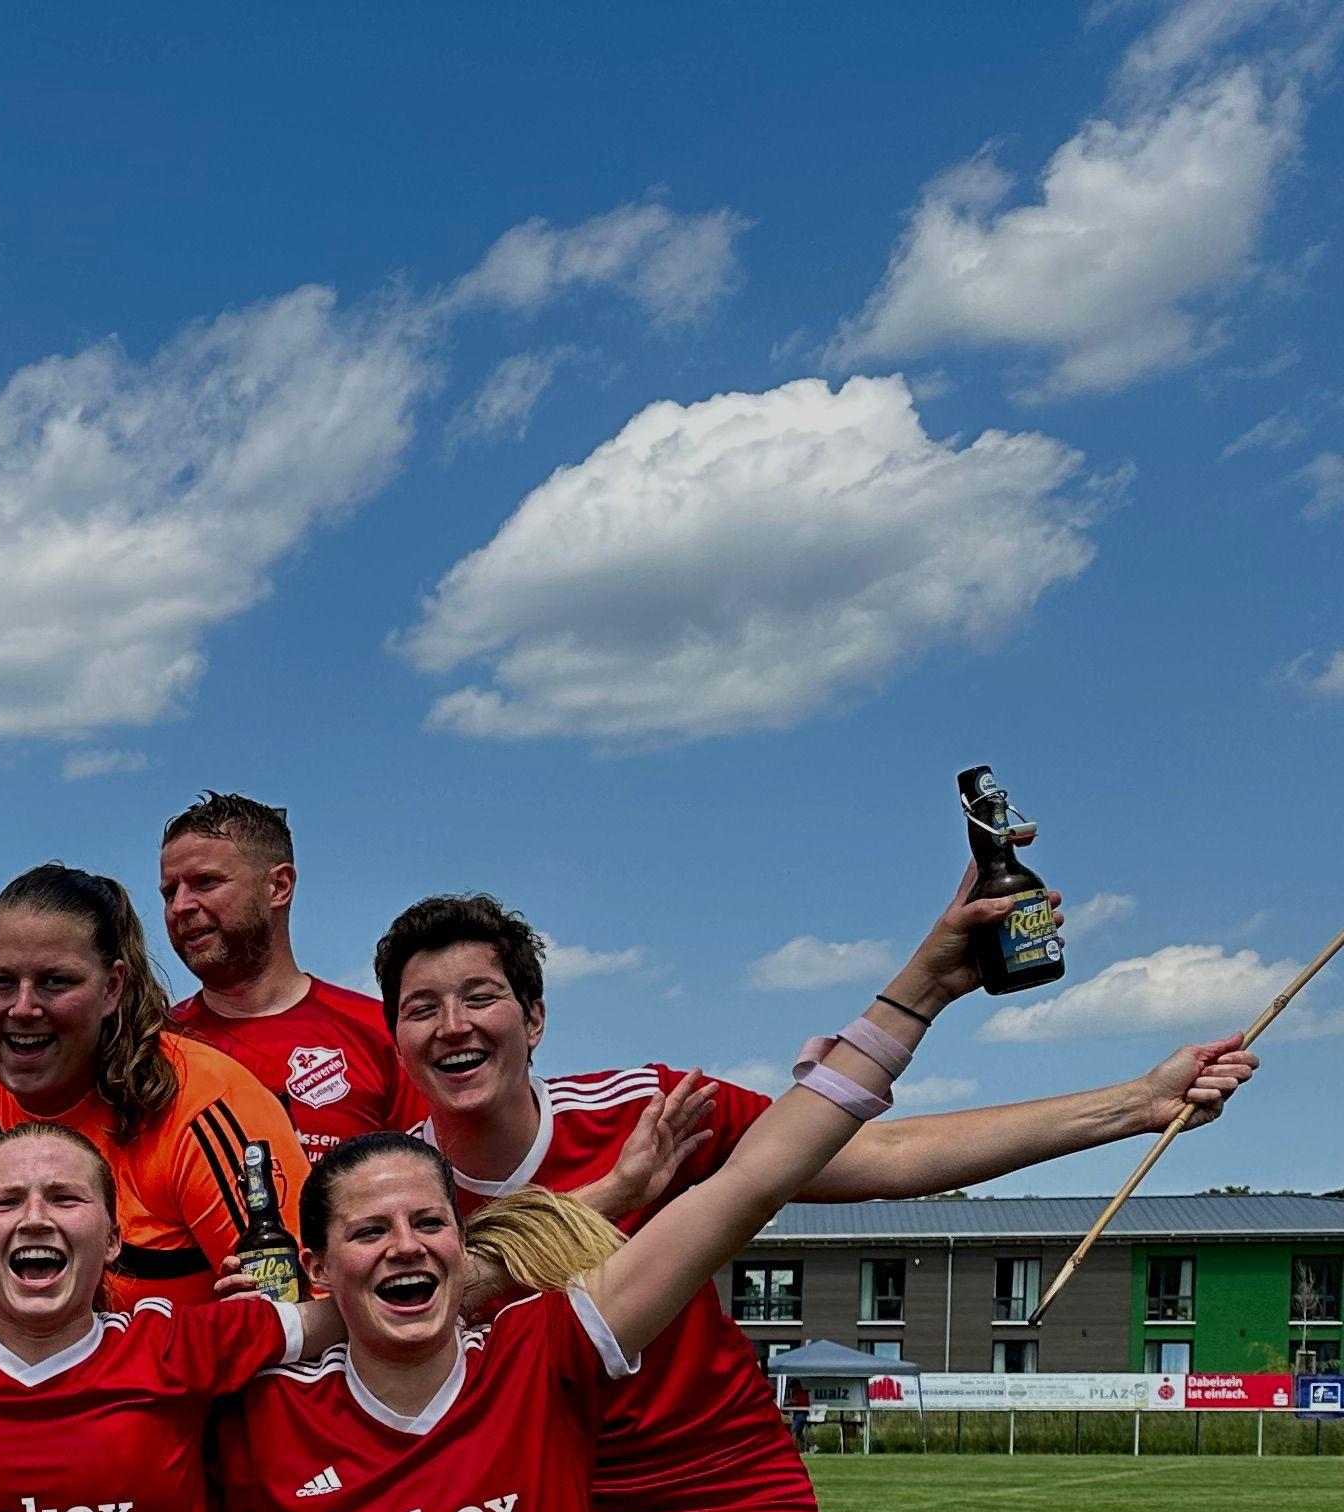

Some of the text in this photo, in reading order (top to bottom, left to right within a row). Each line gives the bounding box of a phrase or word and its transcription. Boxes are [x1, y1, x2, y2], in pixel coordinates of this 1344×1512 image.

[291, 1059, 343, 1093] Sportverein
[1188, 1375, 1243, 1387] Dabeisein
[1188, 1388, 1248, 1400] ist einfach.
